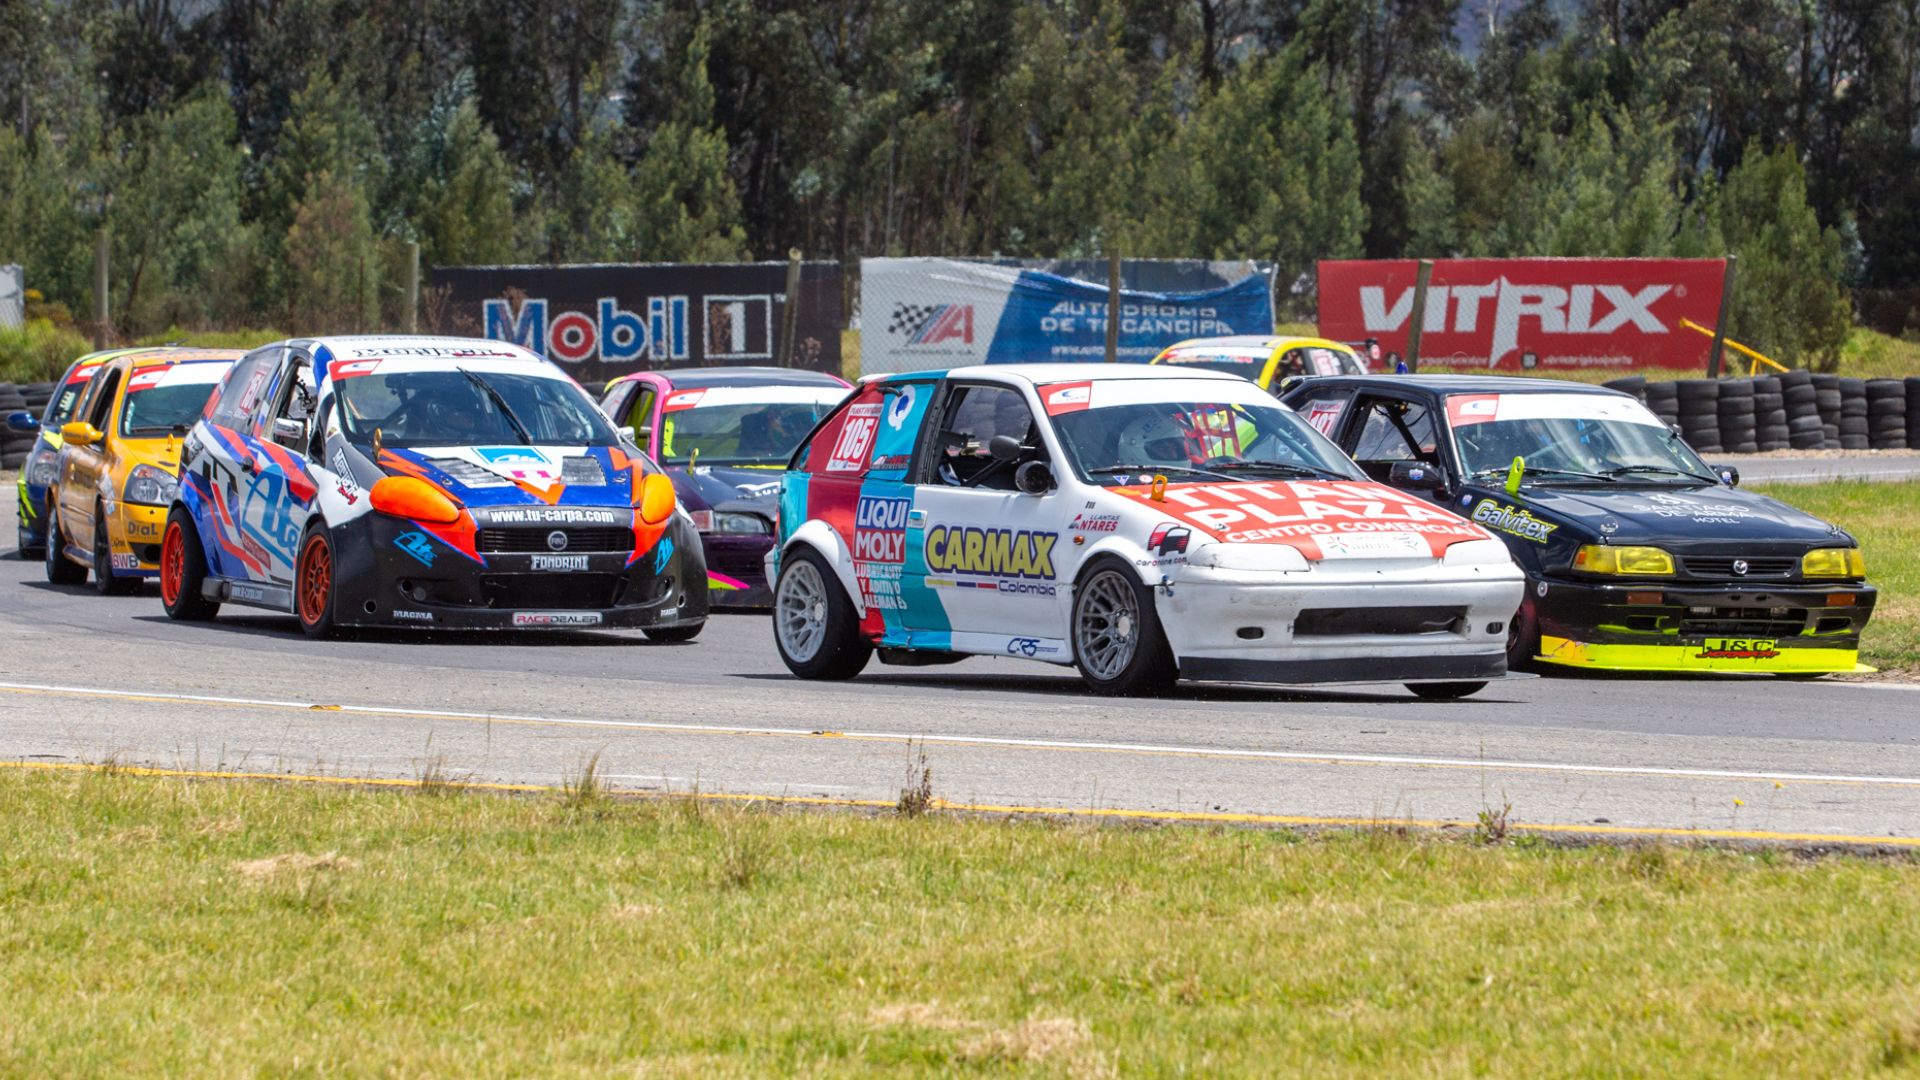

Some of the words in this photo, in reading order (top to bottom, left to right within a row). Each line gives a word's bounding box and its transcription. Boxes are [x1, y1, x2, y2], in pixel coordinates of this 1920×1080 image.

[1049, 300, 1218, 318] AUTDROMO
[1359, 276, 1674, 367] VITRIX
[483, 295, 690, 362] Mobil
[1041, 317, 1075, 332] DE
[1086, 318, 1235, 335] TCANCIPA
[836, 418, 876, 459] 105
[1142, 481, 1416, 510] TITAN
[490, 509, 615, 524] www.tu-carpa.com
[857, 499, 909, 530] LIQUI
[1184, 500, 1467, 531] PLAZA
[1472, 499, 1556, 542] Galvitex
[1226, 522, 1334, 544] CENTRO
[1336, 520, 1487, 539] COMERCIAL
[855, 531, 905, 561] MOLY
[926, 525, 1057, 579] CARMAX
[531, 555, 589, 572] FONDRINI
[999, 579, 1057, 597] Colombia
[392, 610, 434, 621] MAGMA
[515, 614, 600, 624] RACEDEALER
[1706, 640, 1773, 652] J&C
